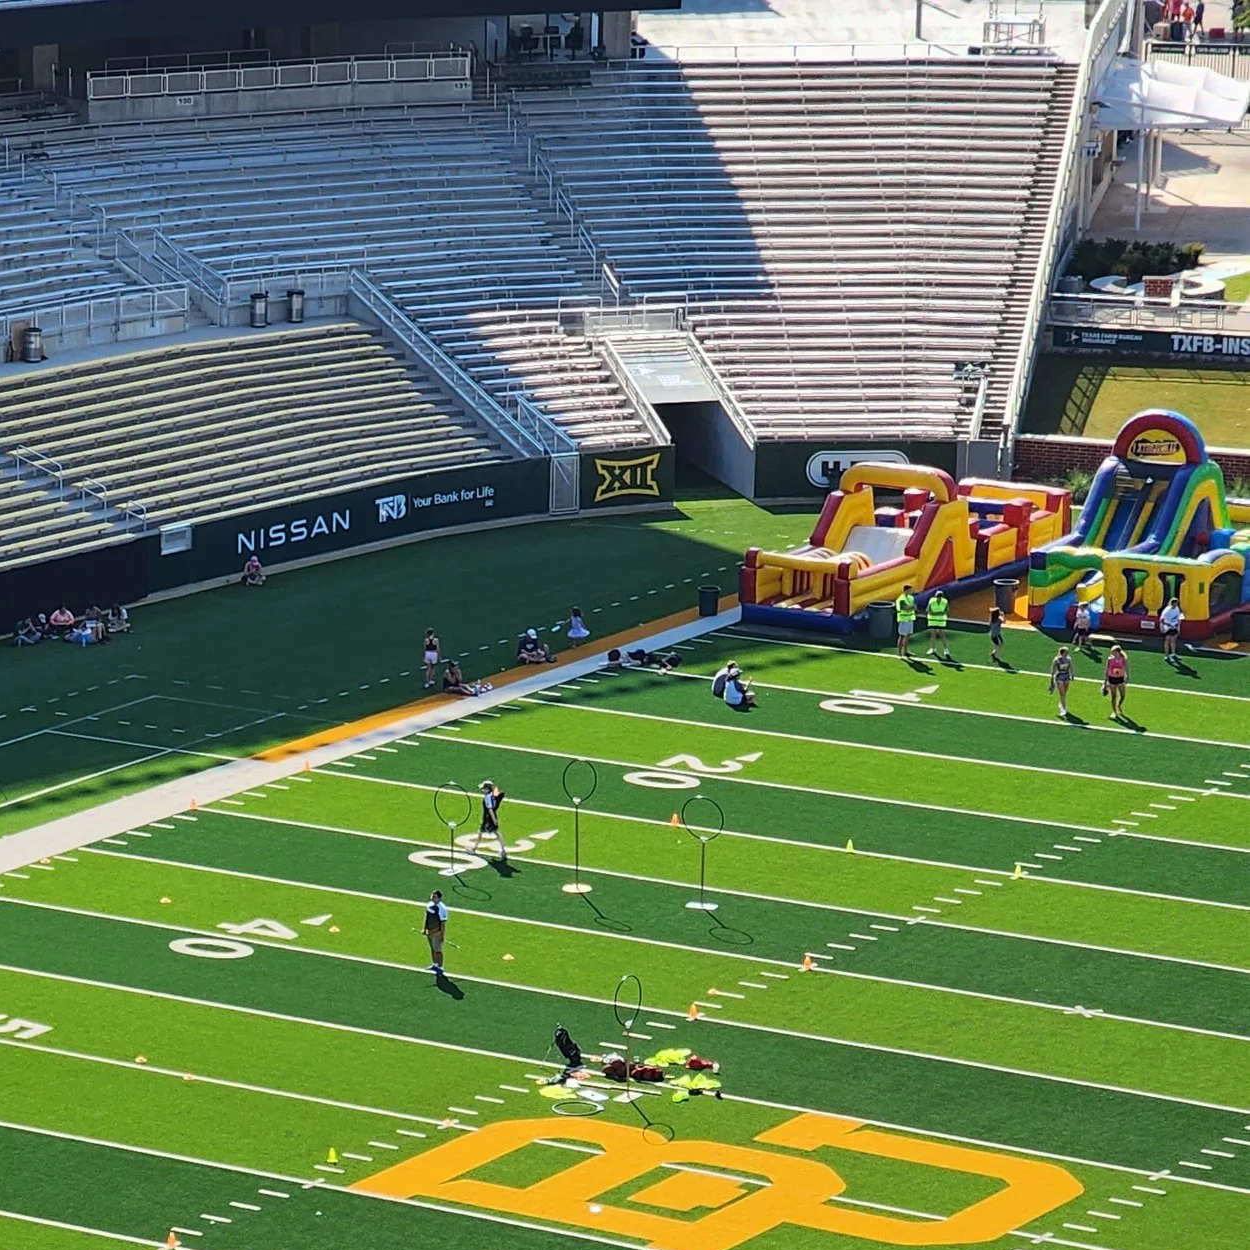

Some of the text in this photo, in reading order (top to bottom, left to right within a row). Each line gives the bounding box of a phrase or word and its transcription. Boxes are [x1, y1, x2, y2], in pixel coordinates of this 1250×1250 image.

[412, 485, 495, 509] Your Bank for Life
[237, 509, 350, 554] NISSAN
[623, 753, 743, 789] 20
